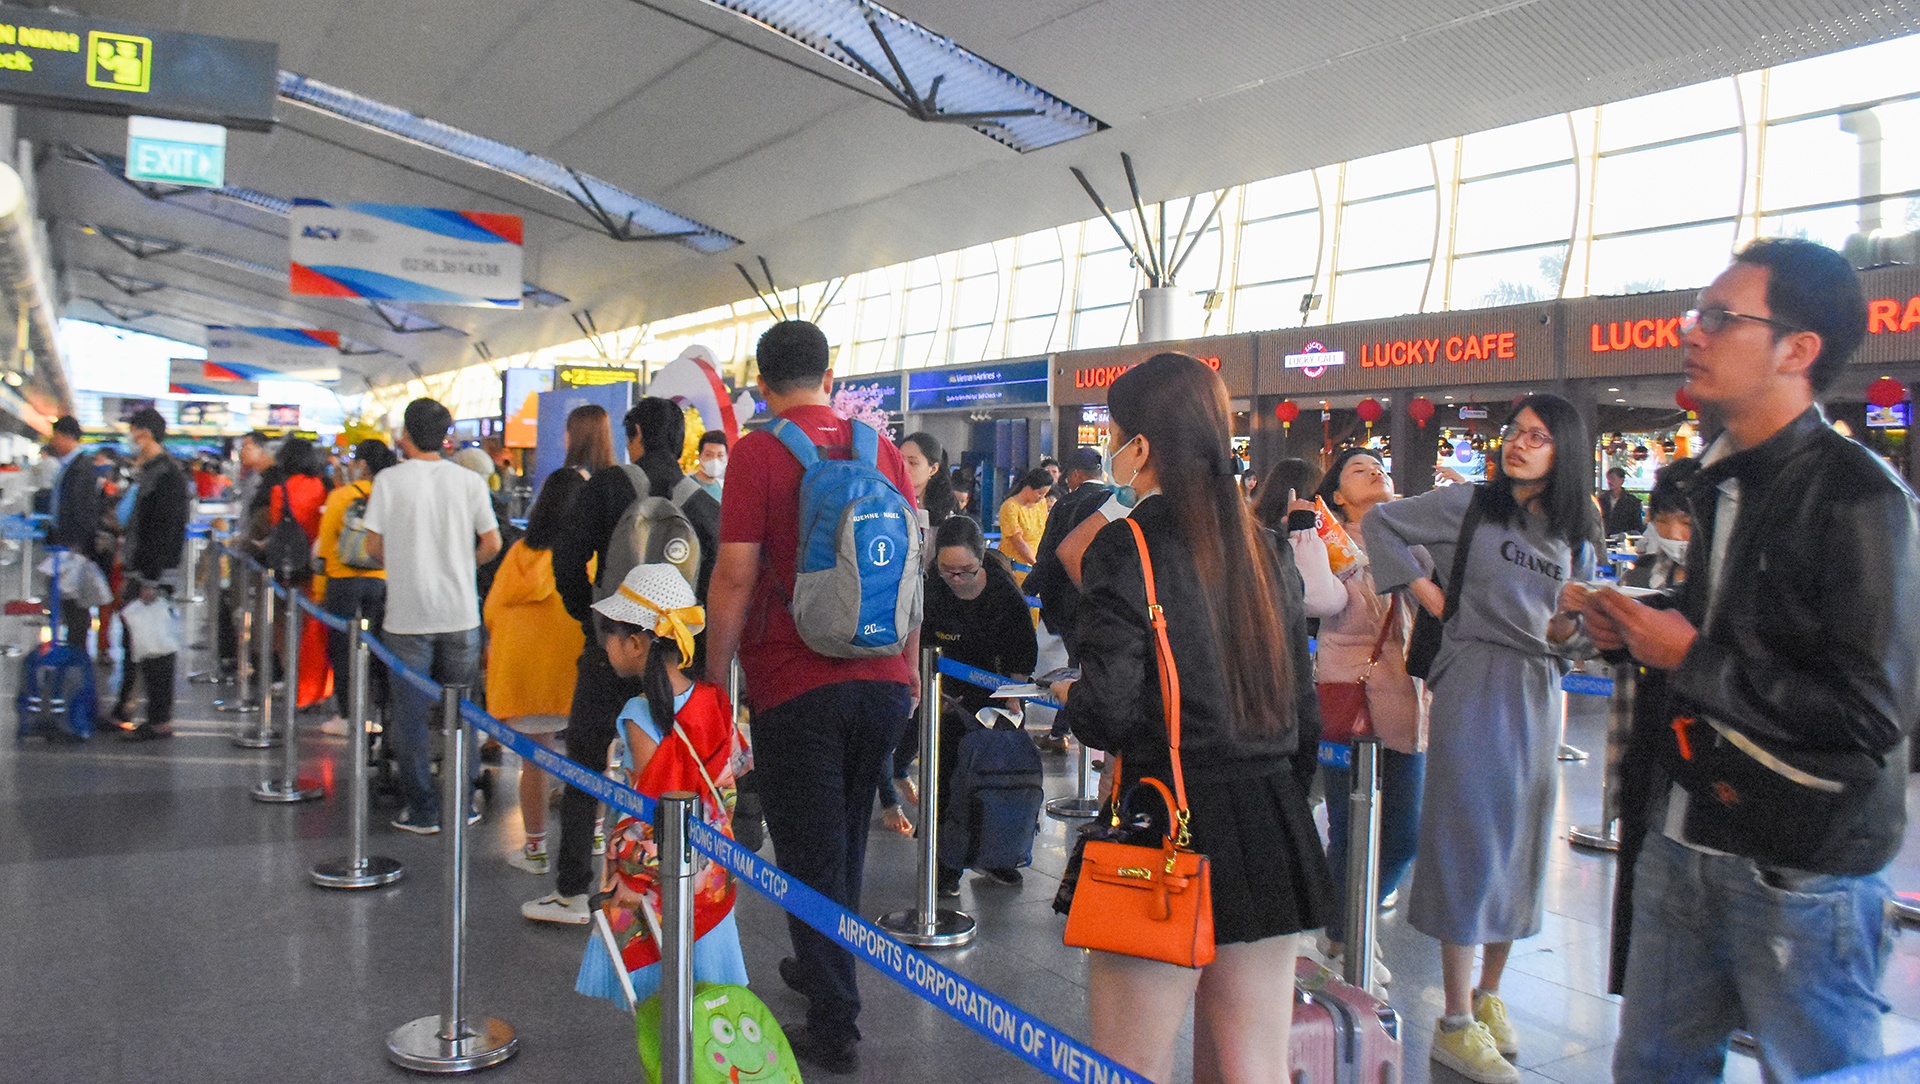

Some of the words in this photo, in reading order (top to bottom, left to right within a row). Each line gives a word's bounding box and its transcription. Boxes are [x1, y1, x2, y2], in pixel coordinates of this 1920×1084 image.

[138, 143, 197, 177] EXIT
[1360, 337, 1440, 368] LUCKY
[1445, 331, 1516, 362] CAFE
[733, 848, 754, 880] NAM
[761, 866, 788, 900] CTCP
[838, 913, 902, 973] AIRPORTS
[905, 952, 1016, 1044] CORPORATION
[1020, 1021, 1046, 1058] OF
